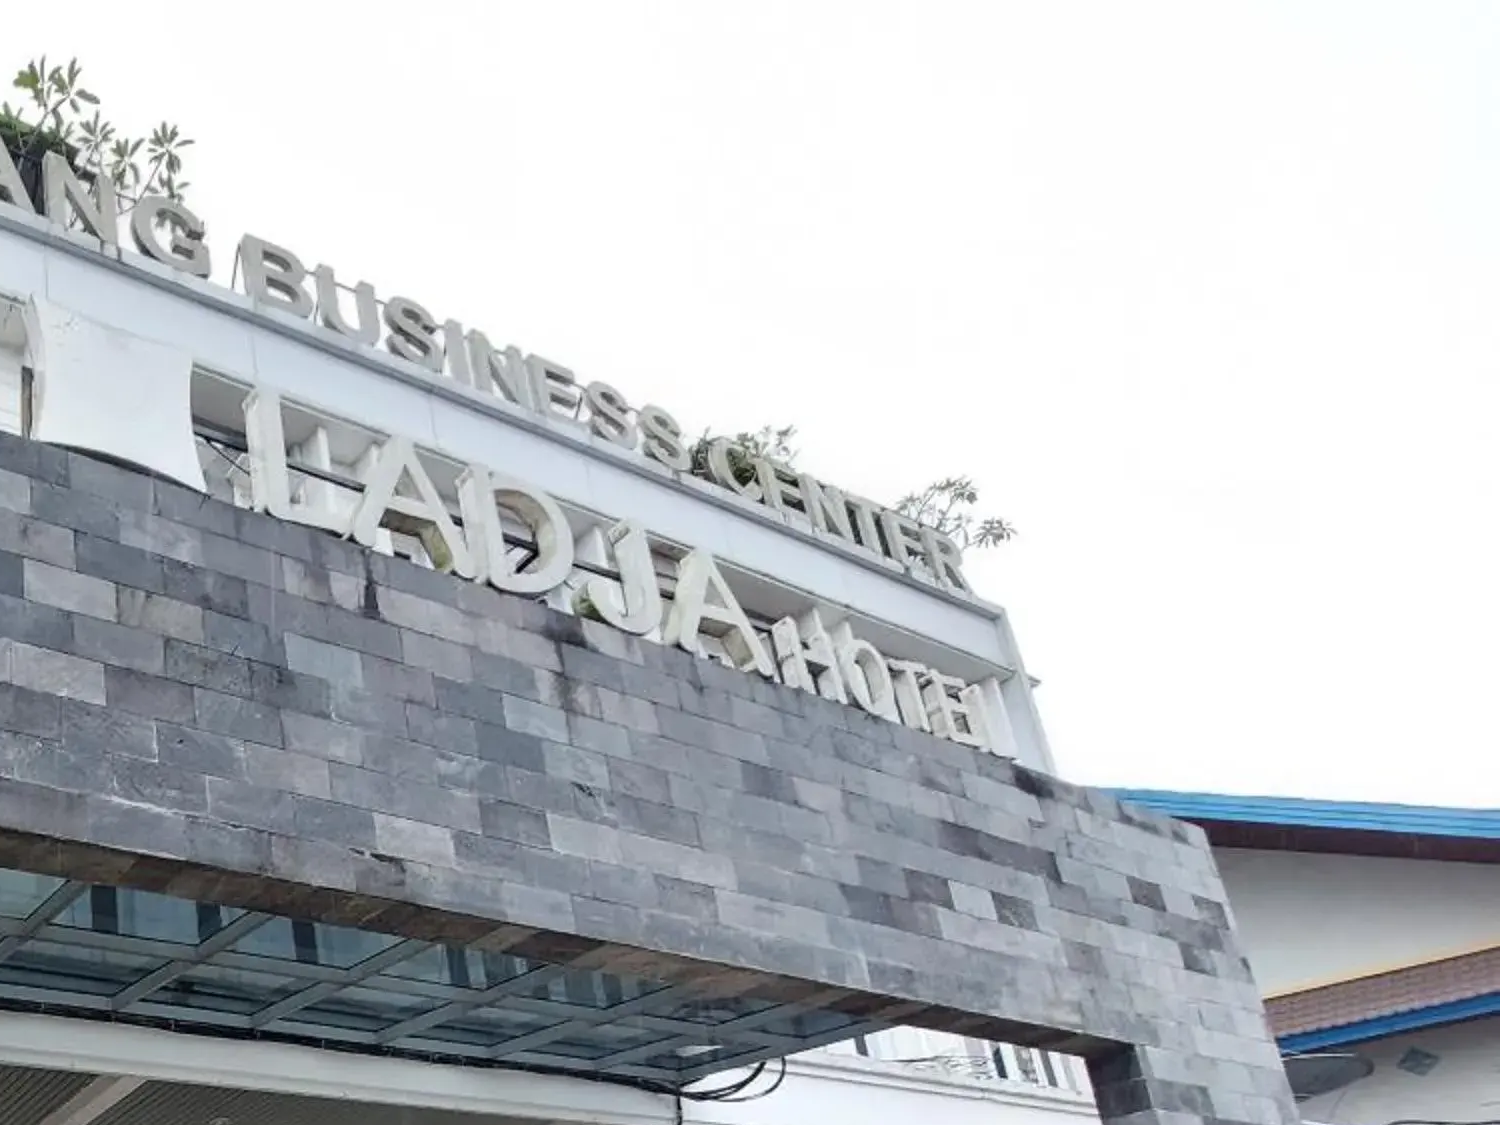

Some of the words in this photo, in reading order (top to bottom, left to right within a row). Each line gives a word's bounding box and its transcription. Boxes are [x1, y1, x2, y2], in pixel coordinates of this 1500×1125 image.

[238, 233, 692, 473] BUSINESS
[706, 436, 975, 594] CENTER
[243, 386, 775, 678] LADJA
[771, 608, 1018, 758] HOTEL
